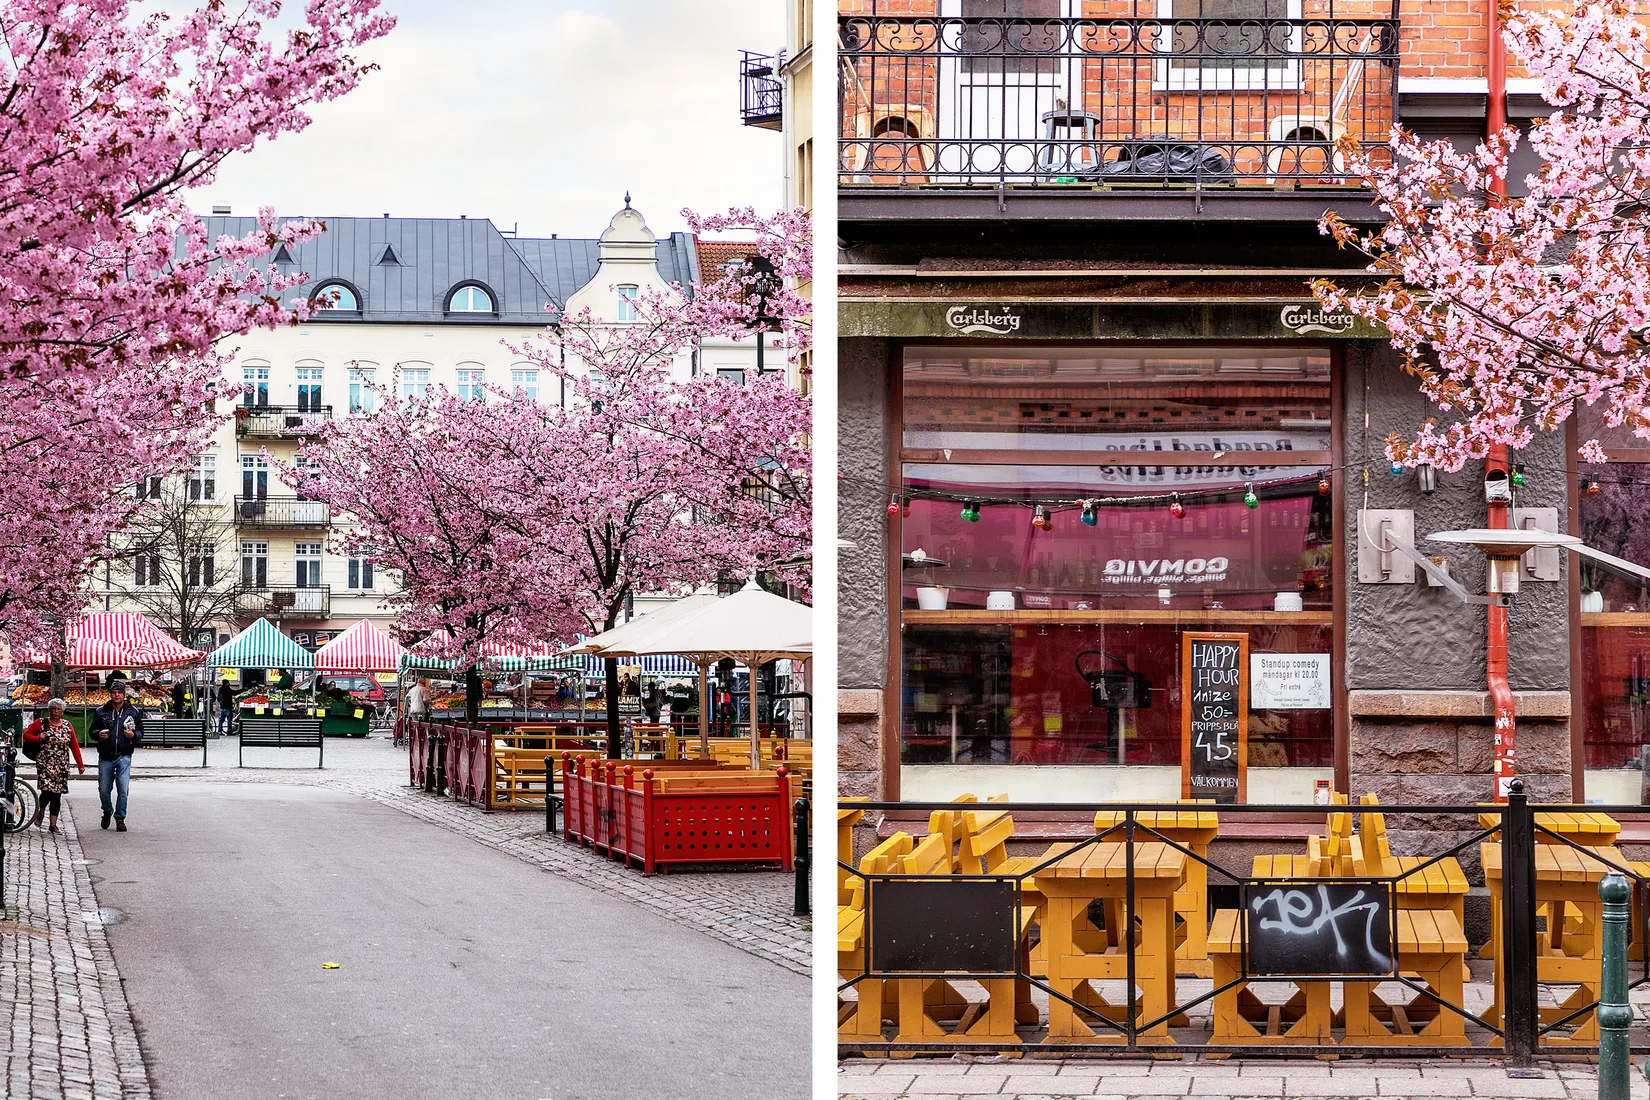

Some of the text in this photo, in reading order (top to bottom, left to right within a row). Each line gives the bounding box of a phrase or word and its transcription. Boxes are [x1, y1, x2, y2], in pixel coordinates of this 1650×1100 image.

[945, 305, 1021, 334] Carlsberg
[1280, 305, 1355, 334] Carlsberg
[1192, 643, 1240, 668] HAPPY
[1261, 658, 1320, 670] Standup comedy
[1198, 668, 1239, 688] HOUR
[1262, 670, 1319, 680] måndagar kl 20.00
[1191, 720, 1222, 732] PRIPPS
